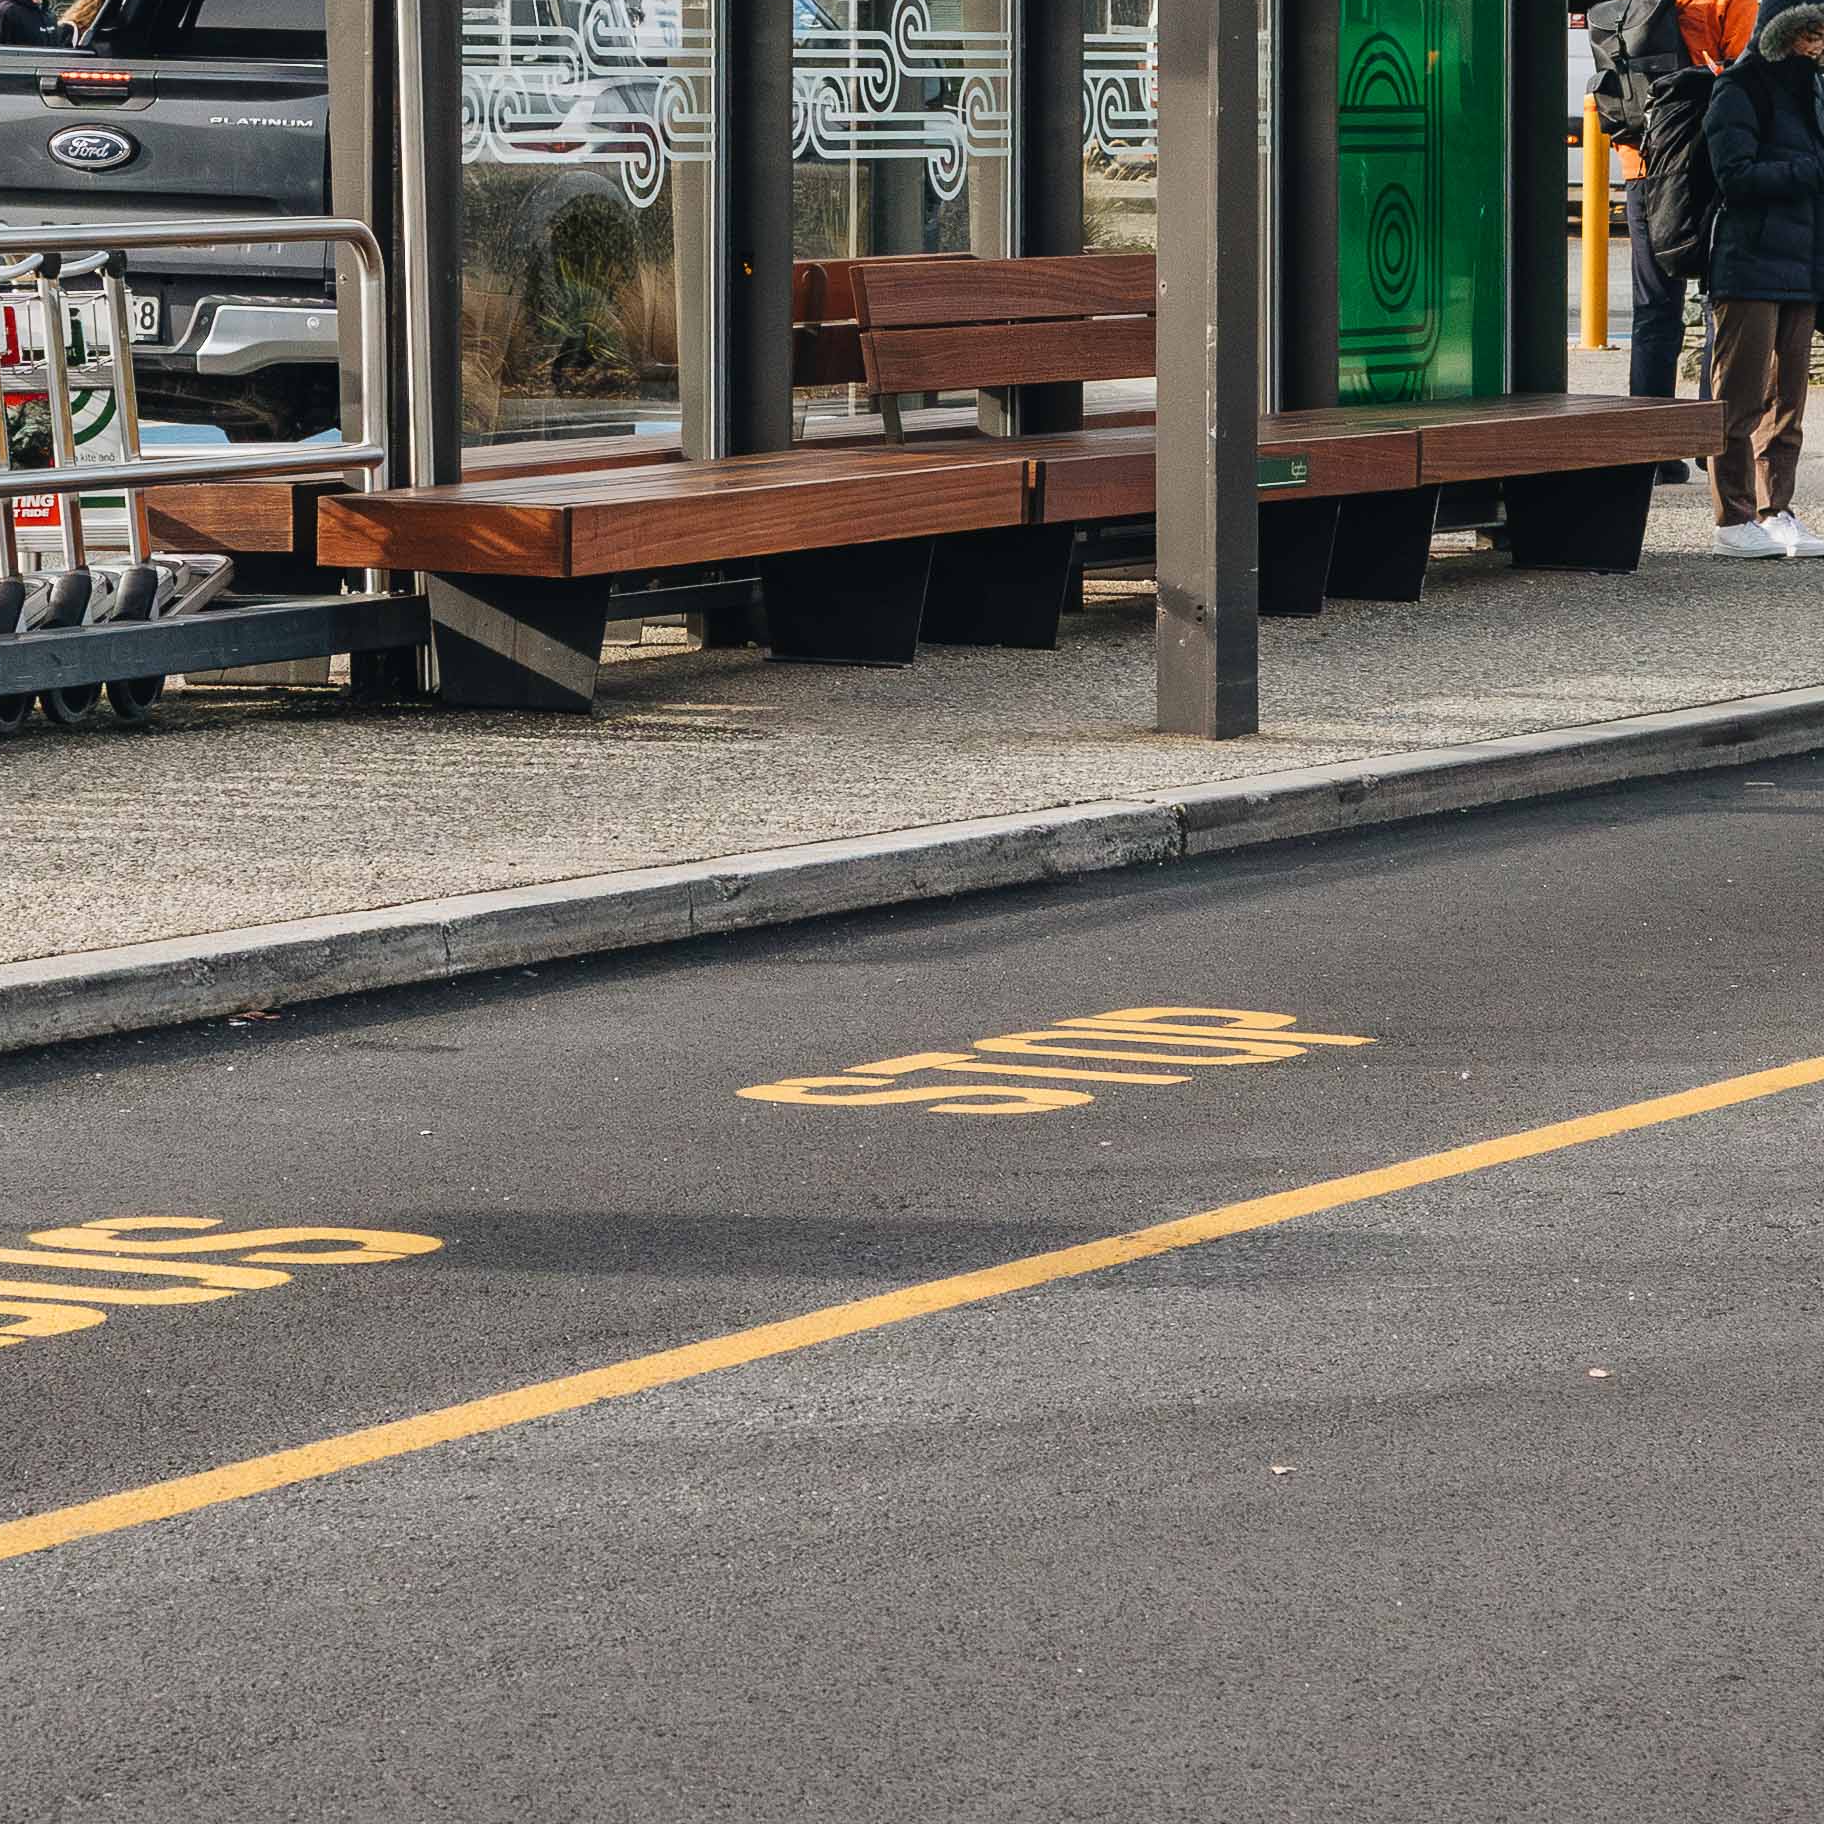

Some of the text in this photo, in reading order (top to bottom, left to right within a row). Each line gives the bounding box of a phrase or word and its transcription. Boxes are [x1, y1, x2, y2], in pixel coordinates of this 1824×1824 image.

[209, 116, 314, 128] PLATINUM
[68, 137, 110, 159] Ford
[21, 508, 49, 518] RIDE
[736, 1007, 1377, 1114] STOP
